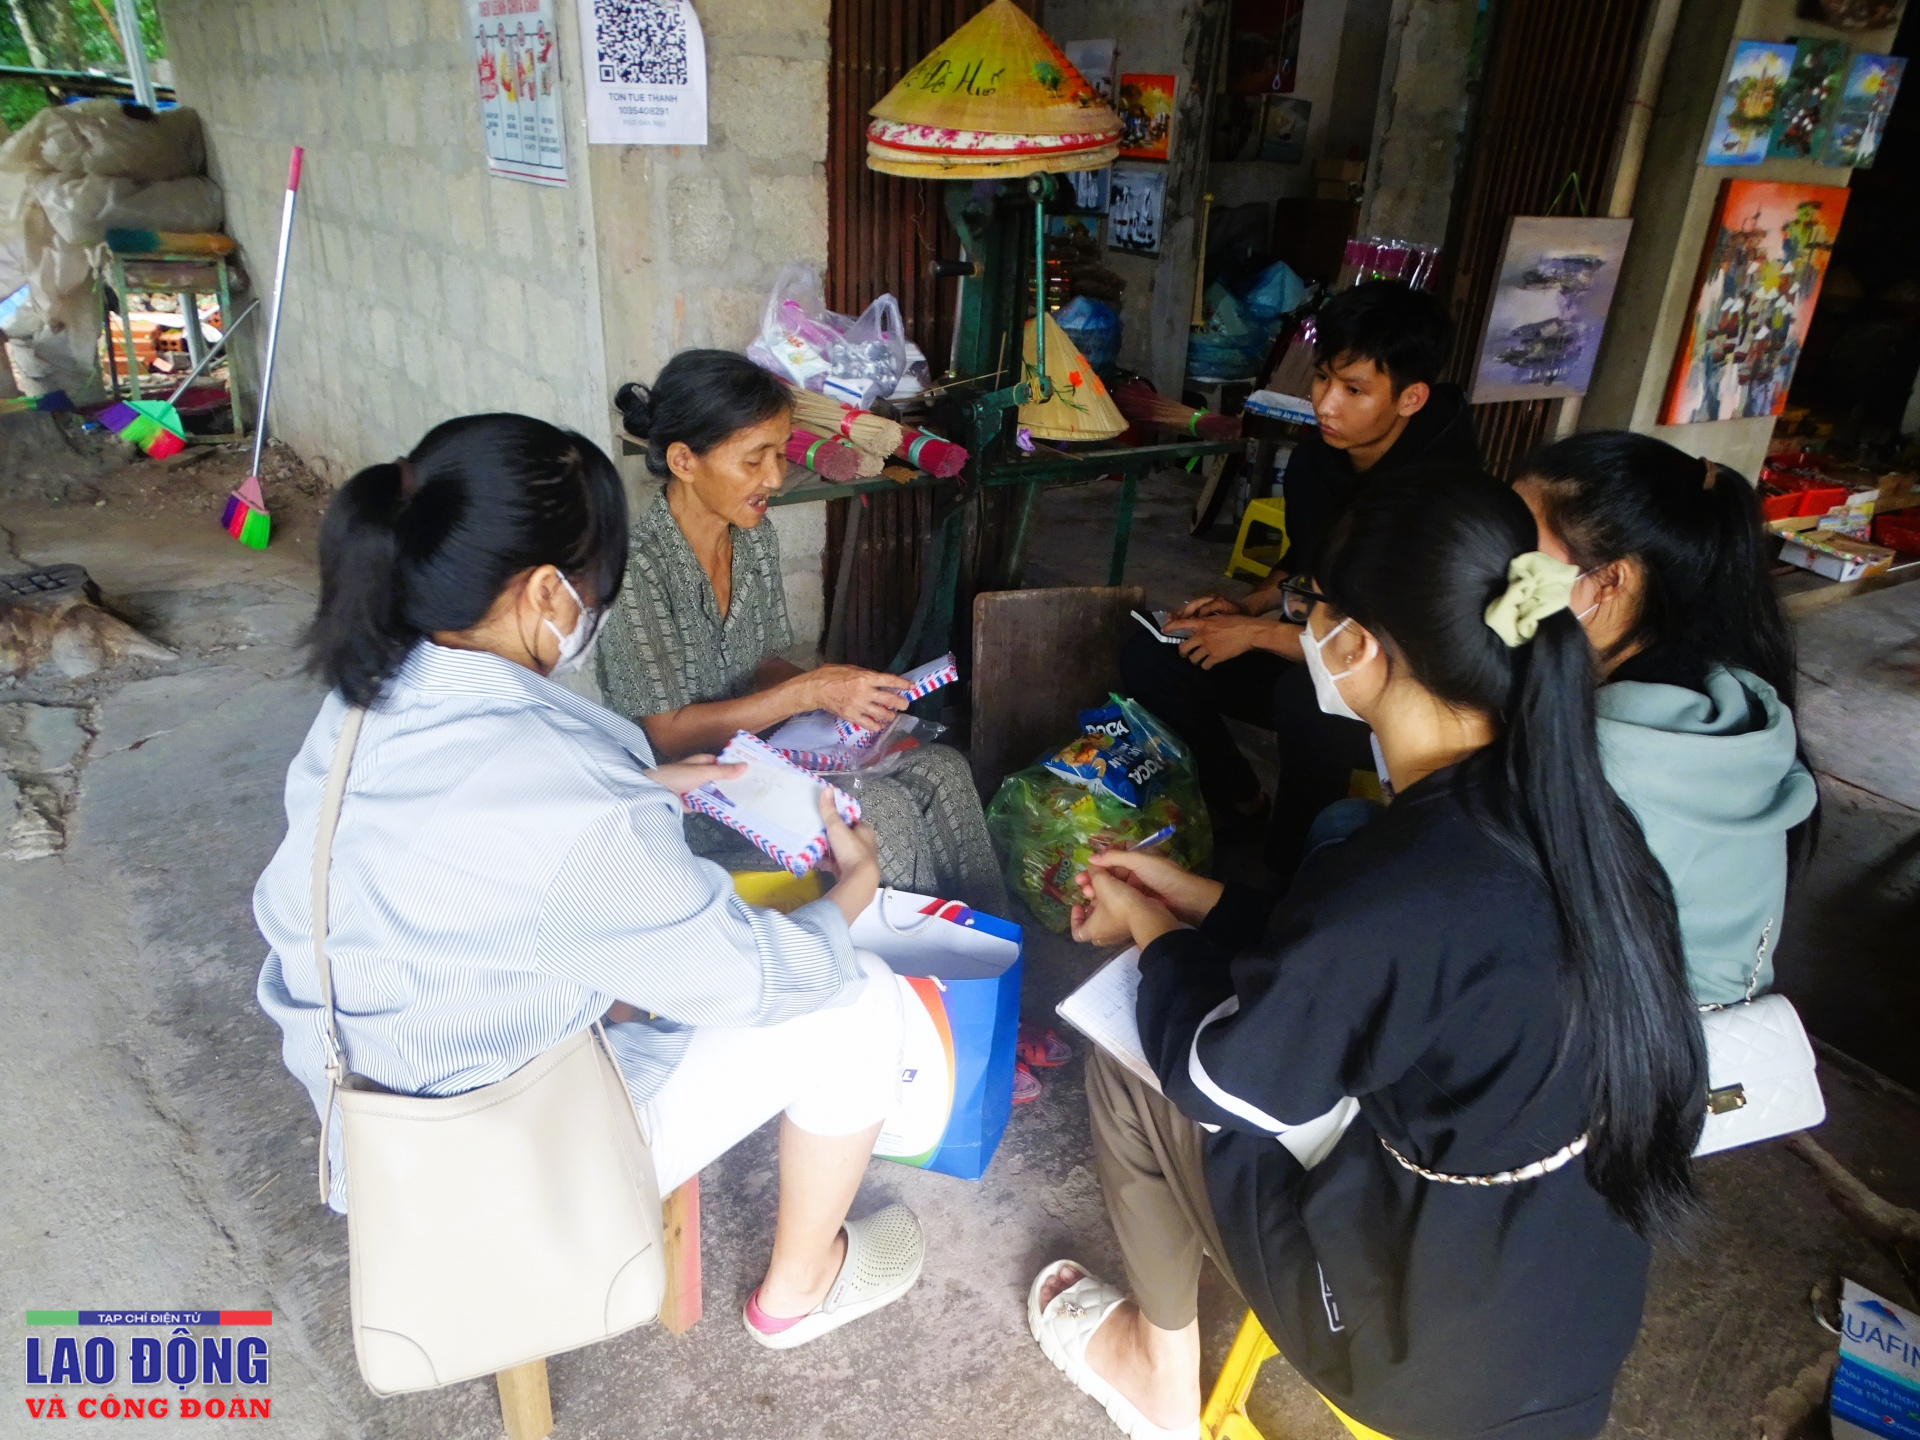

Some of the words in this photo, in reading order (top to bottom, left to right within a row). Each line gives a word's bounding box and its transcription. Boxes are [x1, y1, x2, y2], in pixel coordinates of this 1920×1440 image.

[608, 92, 626, 101] TON
[628, 93, 645, 102] TUE
[648, 94, 678, 103] THANH
